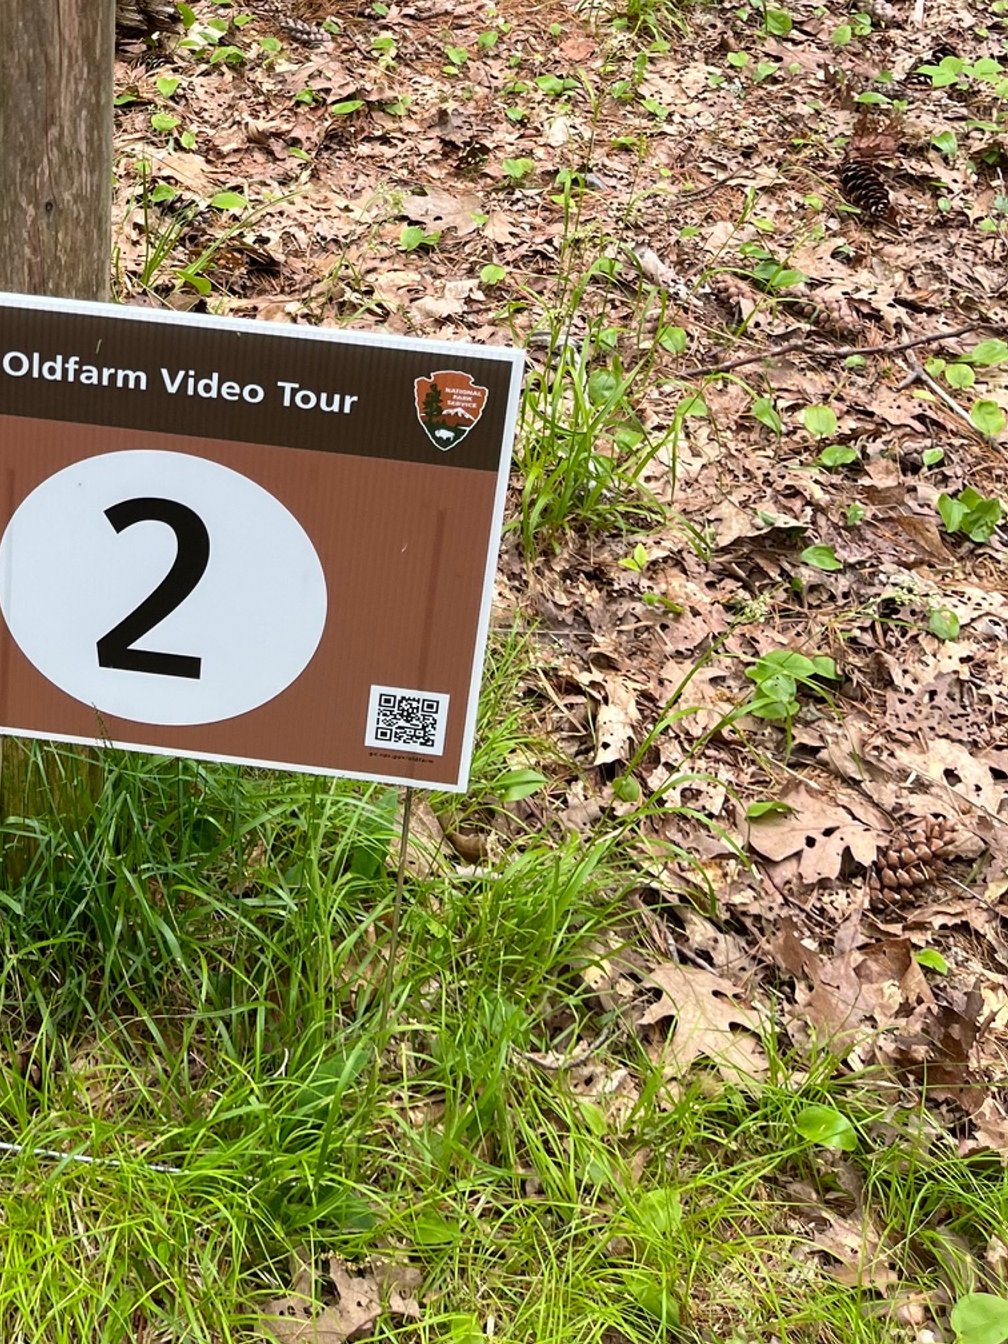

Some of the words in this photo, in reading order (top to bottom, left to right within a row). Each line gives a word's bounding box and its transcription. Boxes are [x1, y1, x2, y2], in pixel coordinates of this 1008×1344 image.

[2, 351, 147, 390] Oldfarm
[161, 368, 264, 404] Video
[276, 382, 358, 414] Tour
[445, 387, 482, 397] NATIONAL
[447, 400, 477, 408] SERVICE
[96, 497, 210, 679] 2
